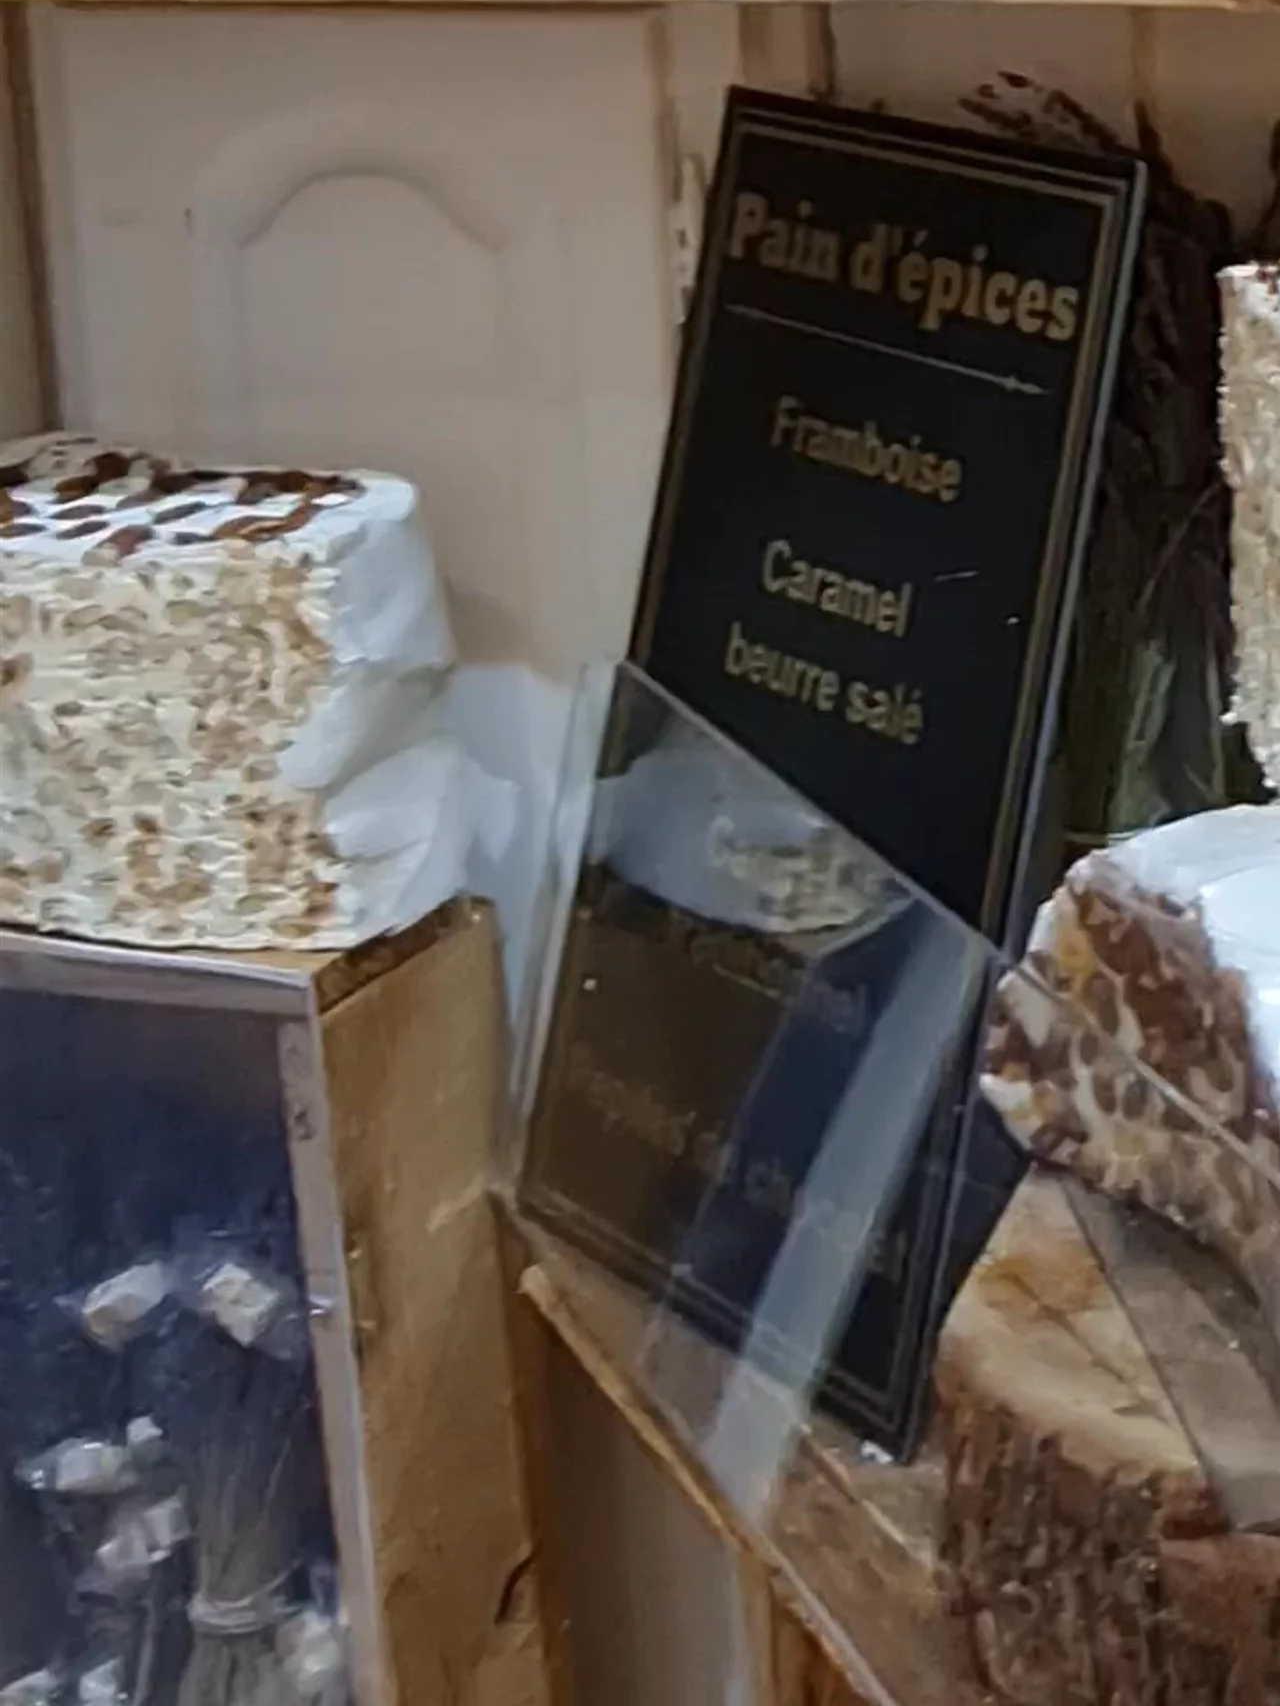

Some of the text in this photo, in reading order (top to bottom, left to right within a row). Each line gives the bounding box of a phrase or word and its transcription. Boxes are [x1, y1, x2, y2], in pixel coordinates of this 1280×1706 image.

[727, 191, 1079, 343] Pain d'épices
[769, 393, 965, 505] Framboise
[760, 538, 915, 637] Caramel
[724, 620, 927, 746] beurre salé
